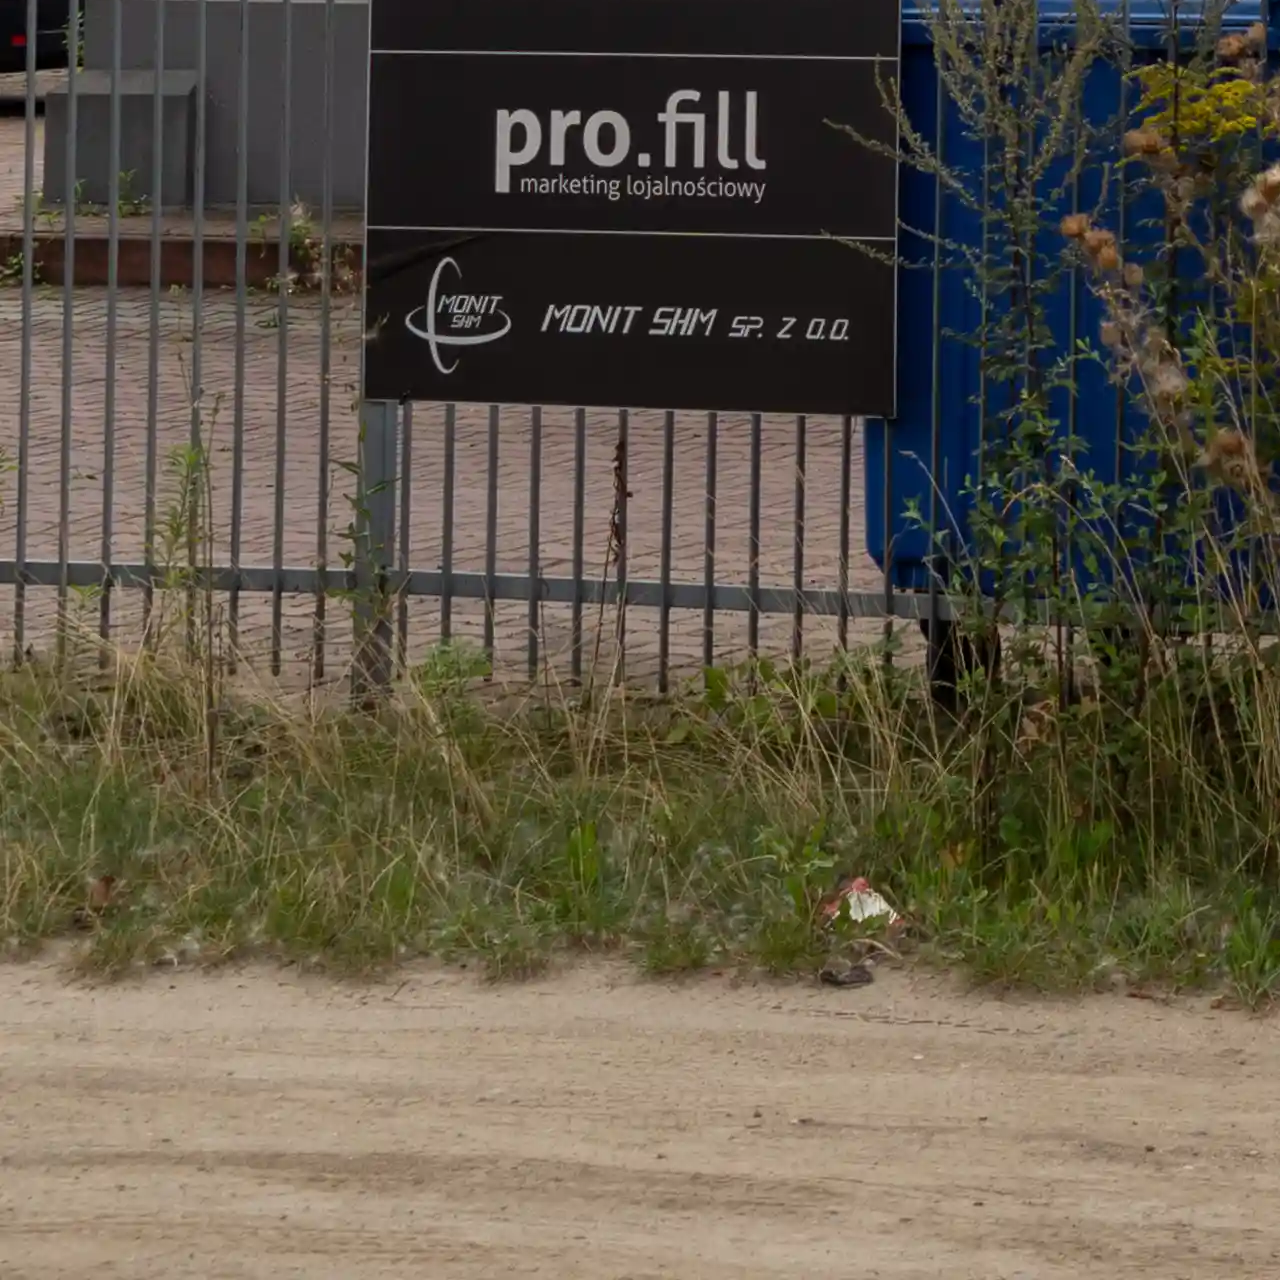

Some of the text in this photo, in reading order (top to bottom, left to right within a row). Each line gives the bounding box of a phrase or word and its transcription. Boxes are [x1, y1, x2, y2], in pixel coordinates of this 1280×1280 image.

[494, 89, 767, 194] pro.fill
[520, 173, 767, 205] marketing lojalnościowy
[437, 294, 504, 314] MONIT
[450, 314, 482, 329] SHM
[541, 304, 643, 335] MONIT
[648, 307, 719, 337] SHM
[728, 316, 765, 338] SP.
[776, 317, 798, 339] Z
